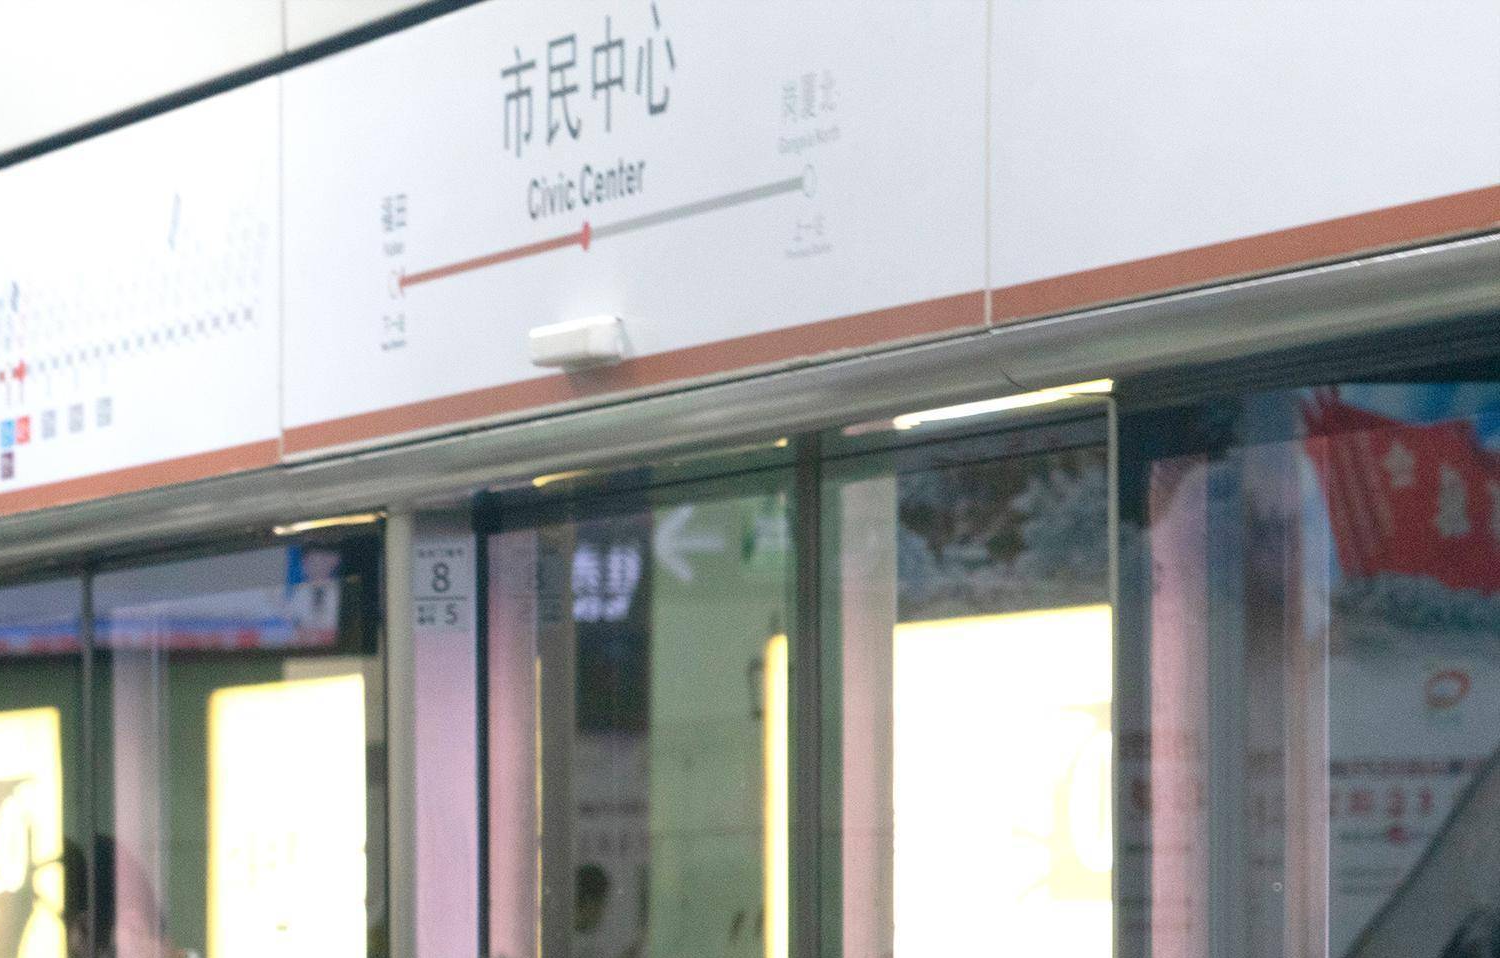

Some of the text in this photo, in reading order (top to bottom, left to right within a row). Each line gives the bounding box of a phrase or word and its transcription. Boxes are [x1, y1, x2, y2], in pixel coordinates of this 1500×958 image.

[501, 2, 675, 157] 市民中心
[528, 159, 645, 220] Civic Center
[431, 562, 450, 593] 8
[445, 603, 458, 625] 5
